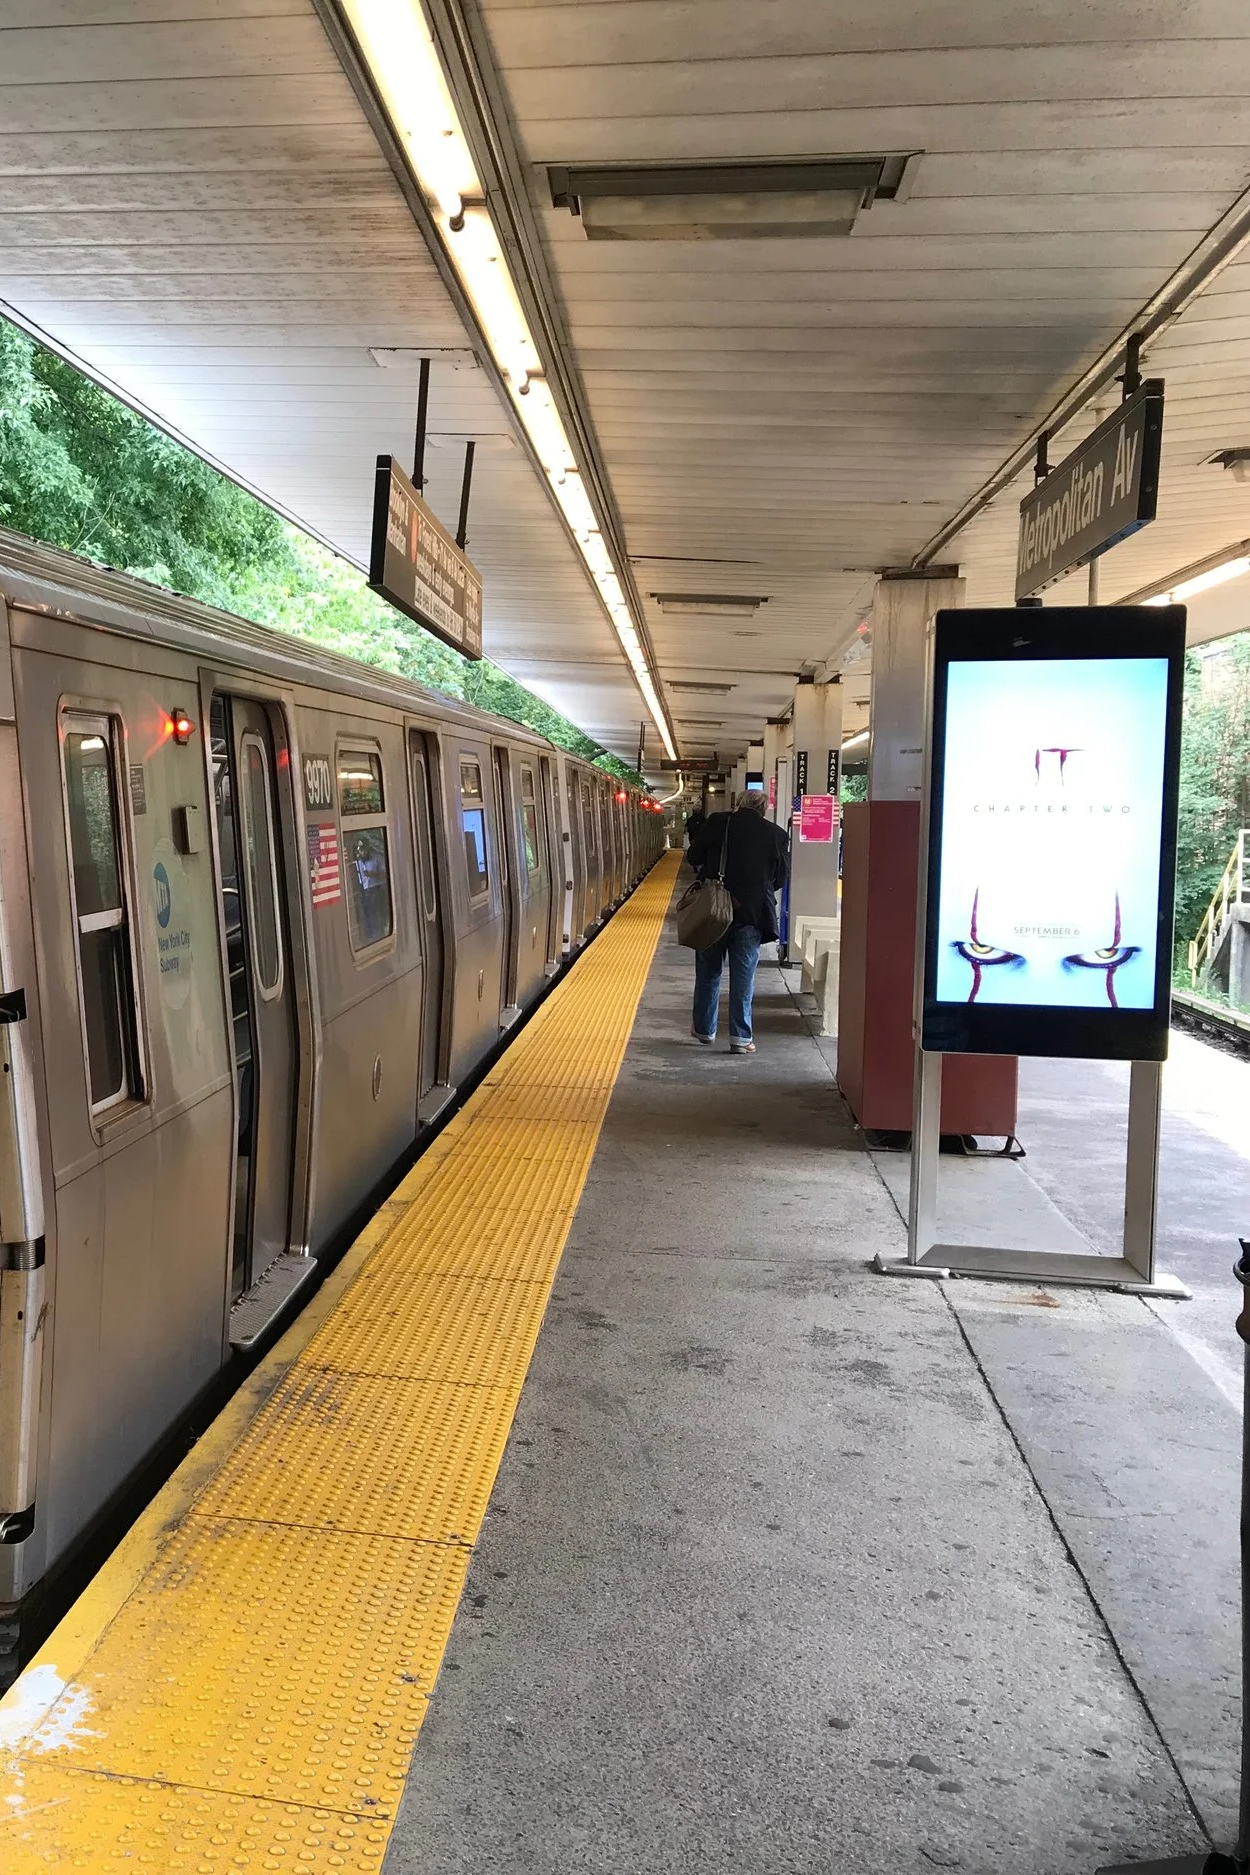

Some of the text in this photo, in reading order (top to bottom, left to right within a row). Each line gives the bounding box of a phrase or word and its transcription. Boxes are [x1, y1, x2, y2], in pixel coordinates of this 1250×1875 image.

[1018, 423, 1139, 576] Metropolitan Av
[306, 760, 330, 804] 9970
[1034, 748, 1085, 787] IT
[973, 805, 1130, 814] CHAPTER TWO
[1014, 926, 1071, 935] SEPTEMBER
